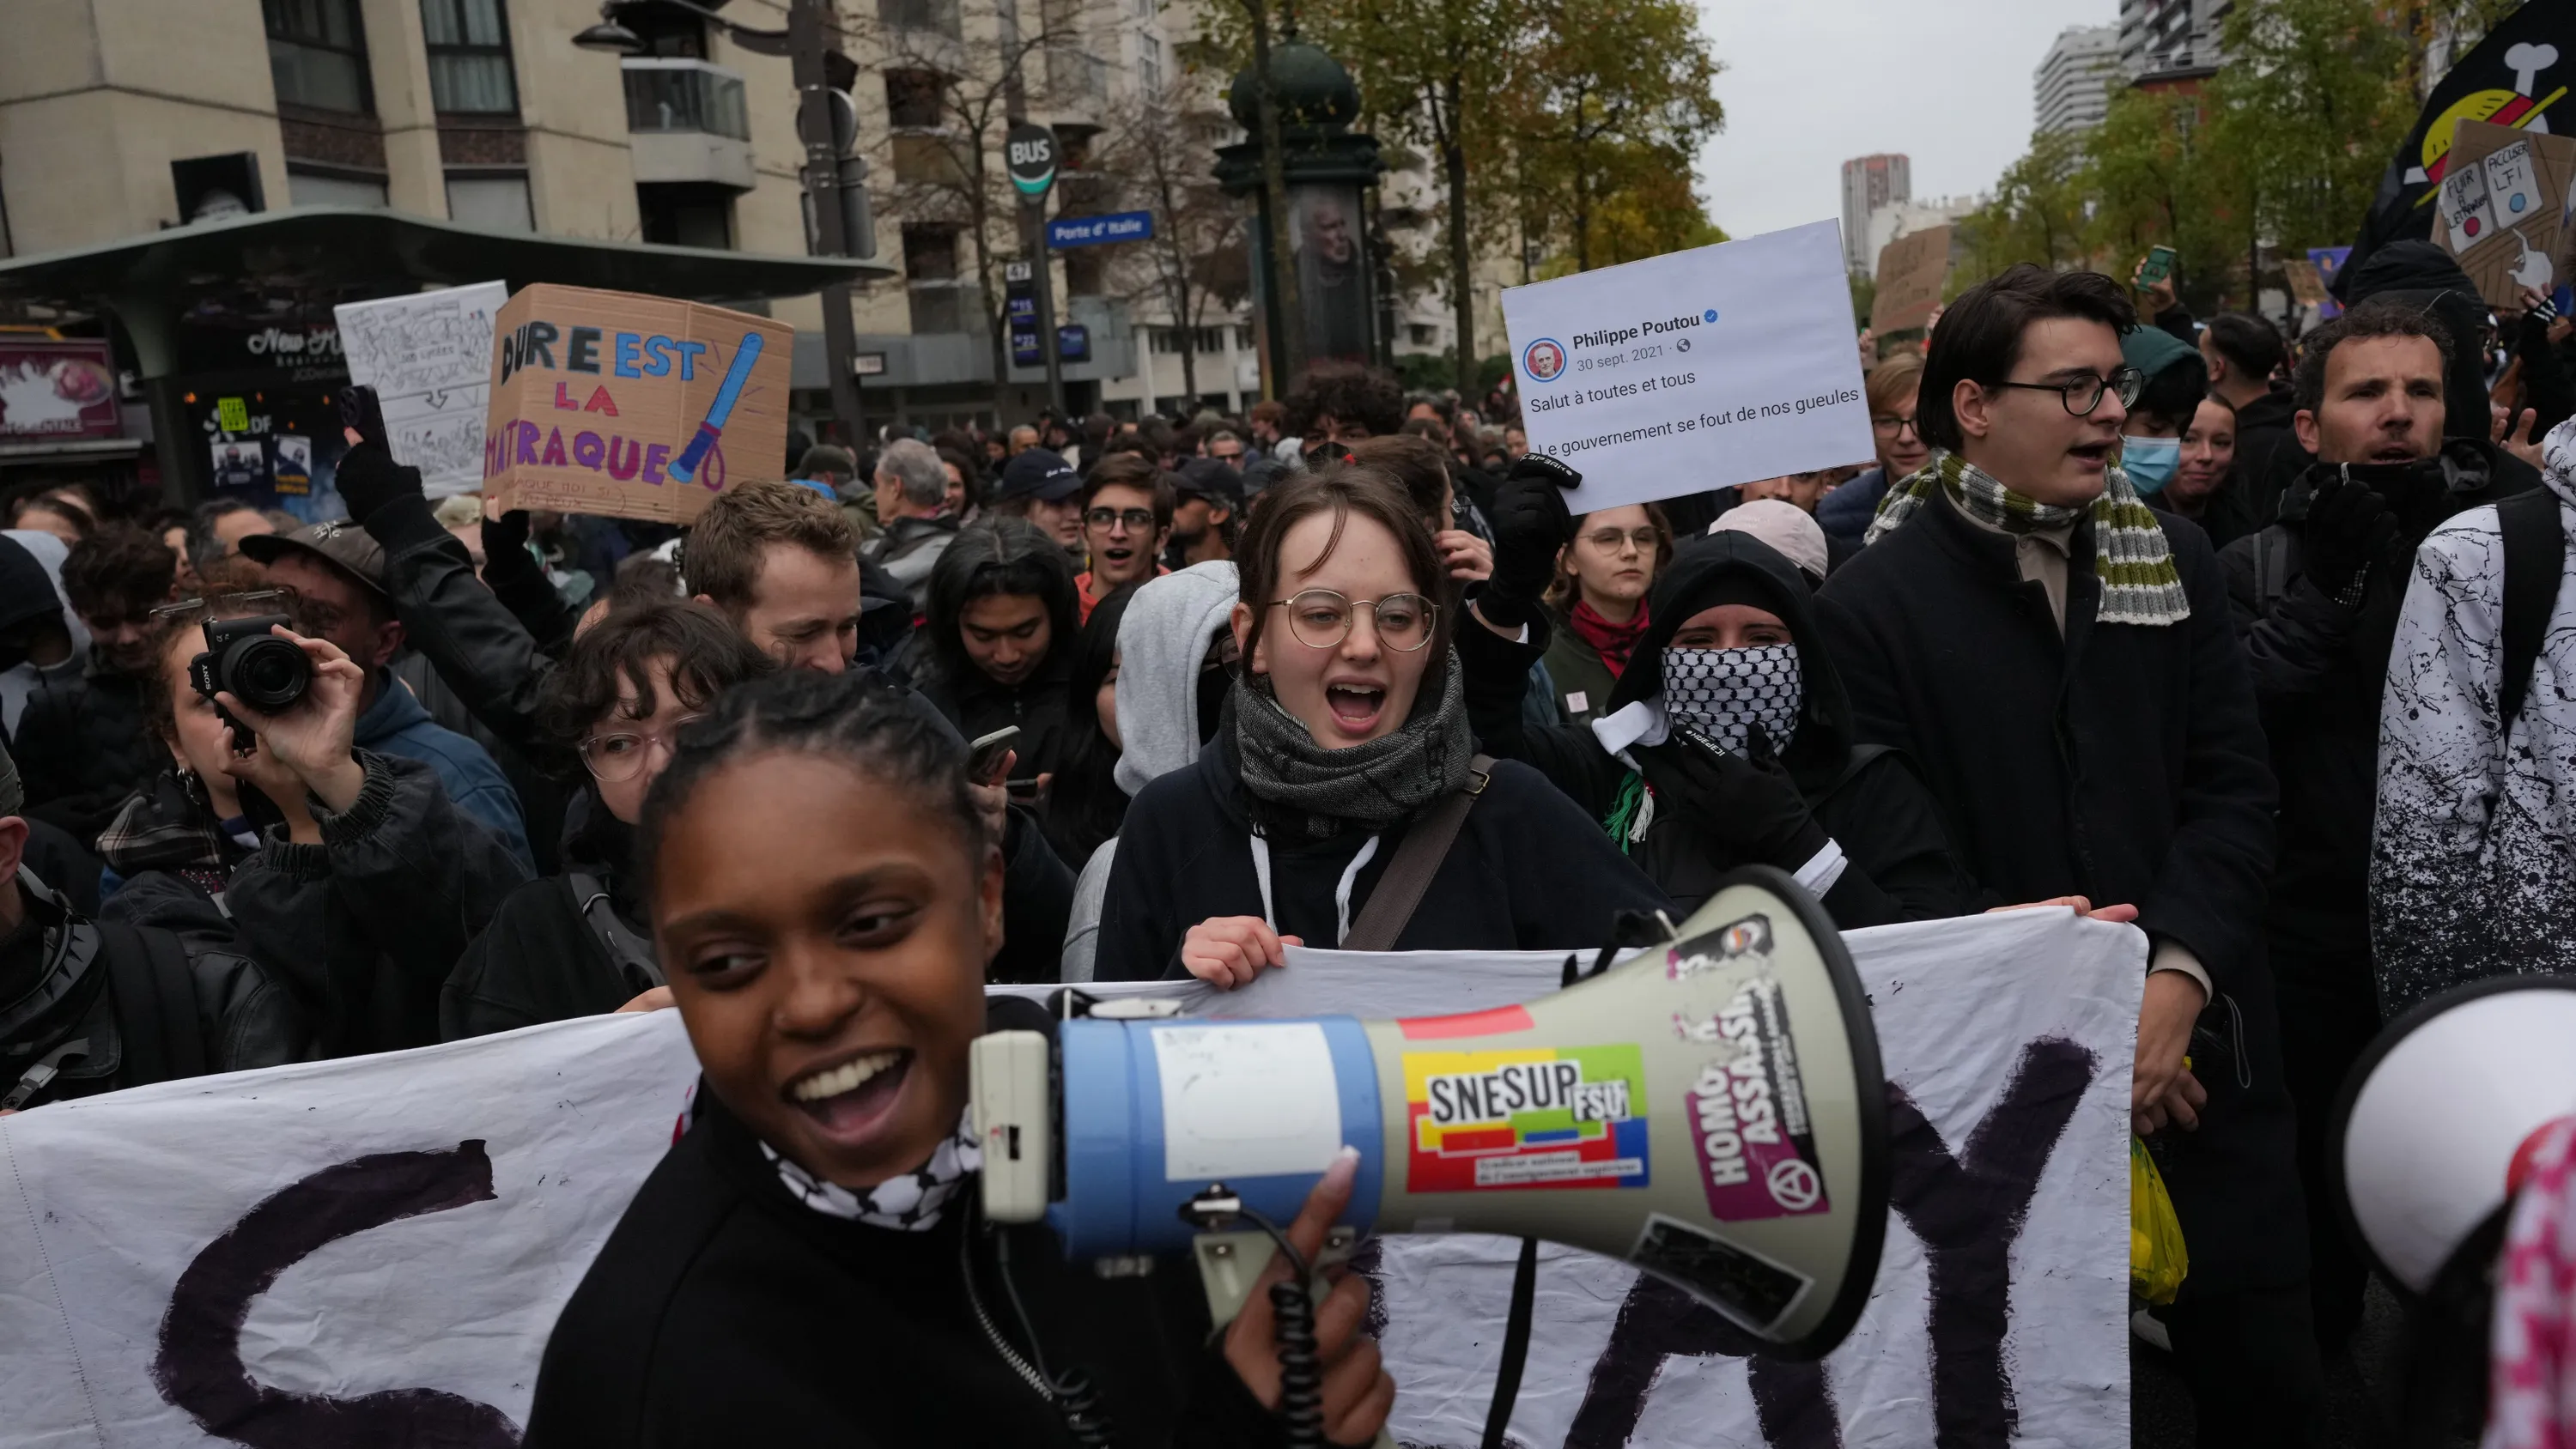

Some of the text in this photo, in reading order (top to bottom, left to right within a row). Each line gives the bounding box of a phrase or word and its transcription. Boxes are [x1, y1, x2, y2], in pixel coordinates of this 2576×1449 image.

[1011, 139, 1051, 165] BUS
[2488, 143, 2529, 171] ACCUSER
[2445, 169, 2475, 198] FUIR
[2494, 166, 2523, 191] LFI
[1054, 226, 1090, 240] Porte
[1108, 219, 1142, 234] Italie
[1011, 264, 1027, 276] 47
[1572, 314, 1701, 349] Philippe Poutou
[615, 332, 706, 381] EST
[1577, 345, 1663, 372] 30 sept. 2021
[554, 381, 620, 417] LA
[1531, 373, 1696, 413] Salut à toutes et tous
[1538, 389, 1859, 457] Le gouvernement se fout de nos gueules
[483, 419, 671, 487] MATRAQUE
[201, 664, 211, 690] SONY
[1690, 732, 1726, 757] ICEPEAK
[1431, 1063, 1577, 1123] SNESUP
[1574, 1083, 1630, 1123] FSU
